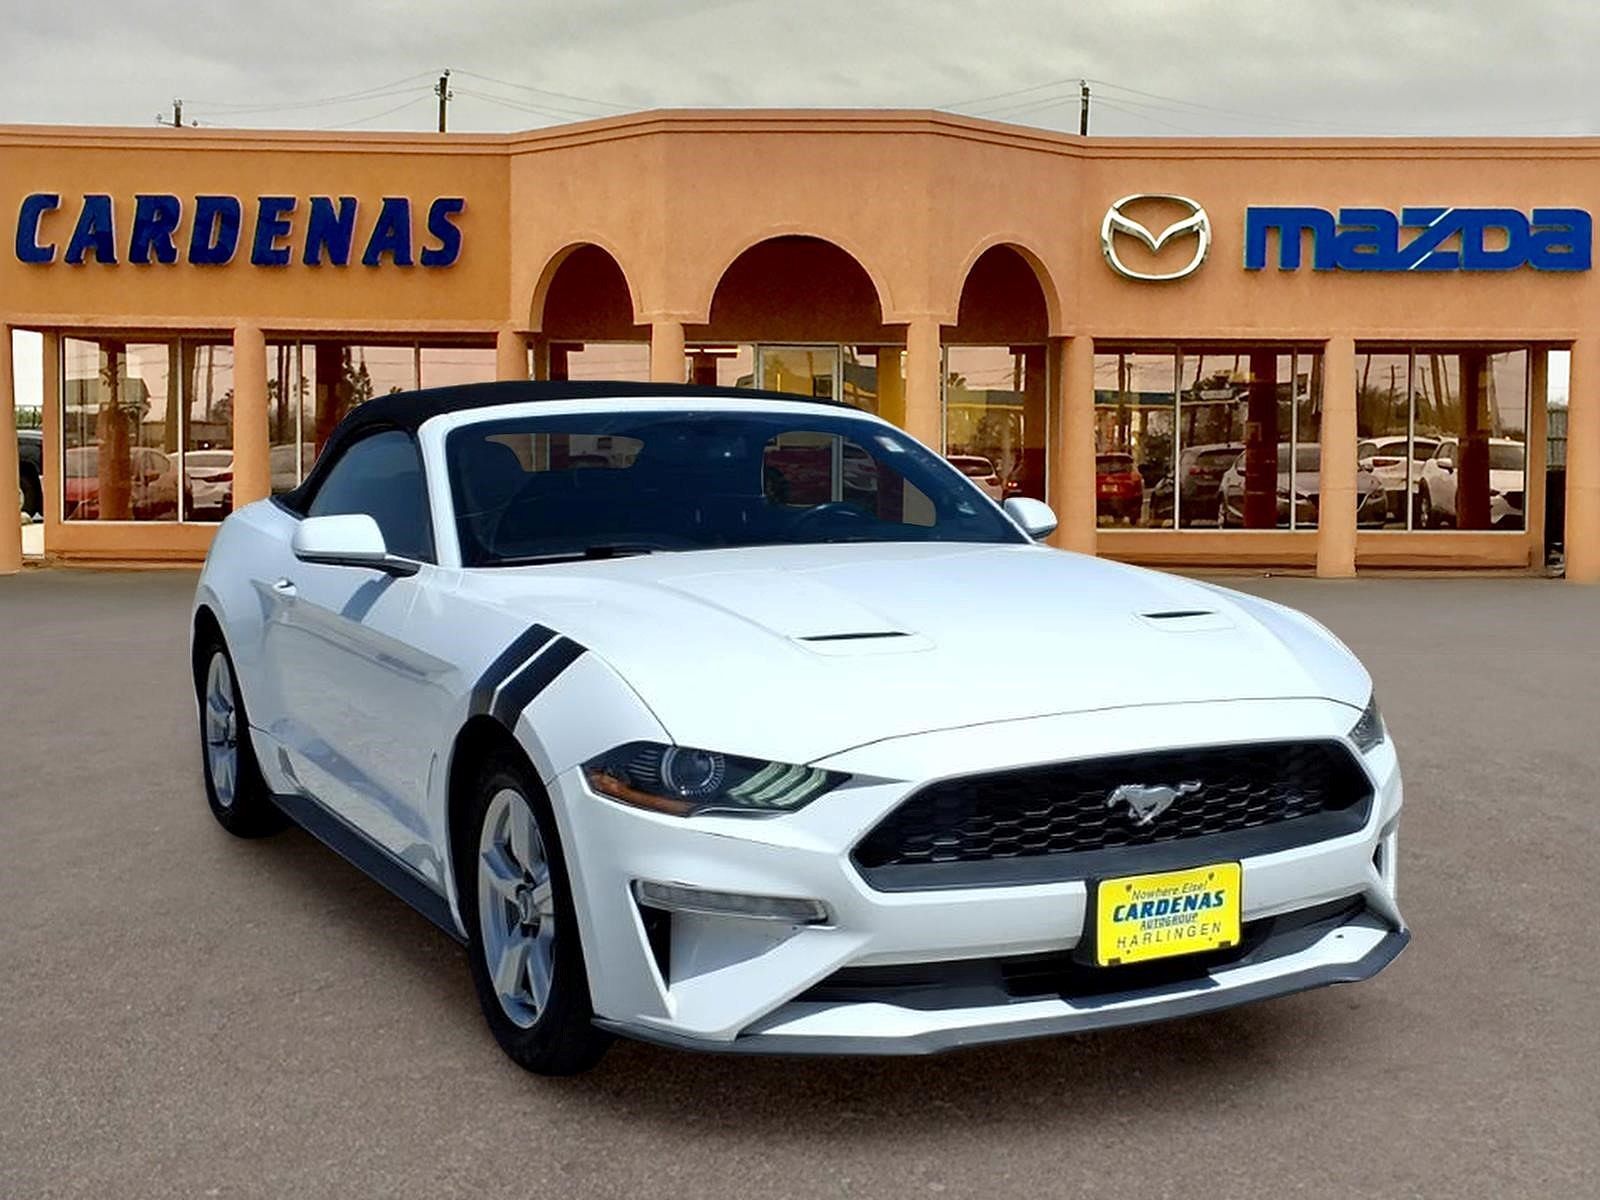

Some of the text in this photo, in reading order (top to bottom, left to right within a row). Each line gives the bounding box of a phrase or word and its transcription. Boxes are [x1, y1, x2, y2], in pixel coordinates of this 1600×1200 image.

[15, 193, 466, 267] CARDENAS
[1243, 206, 1593, 271] mazda
[1113, 890, 1225, 922] CARDENAS
[1131, 887, 1179, 901] Nowhere
[1117, 922, 1221, 949] HARLINGEN
[1140, 912, 1198, 931] AUTOGROUP
